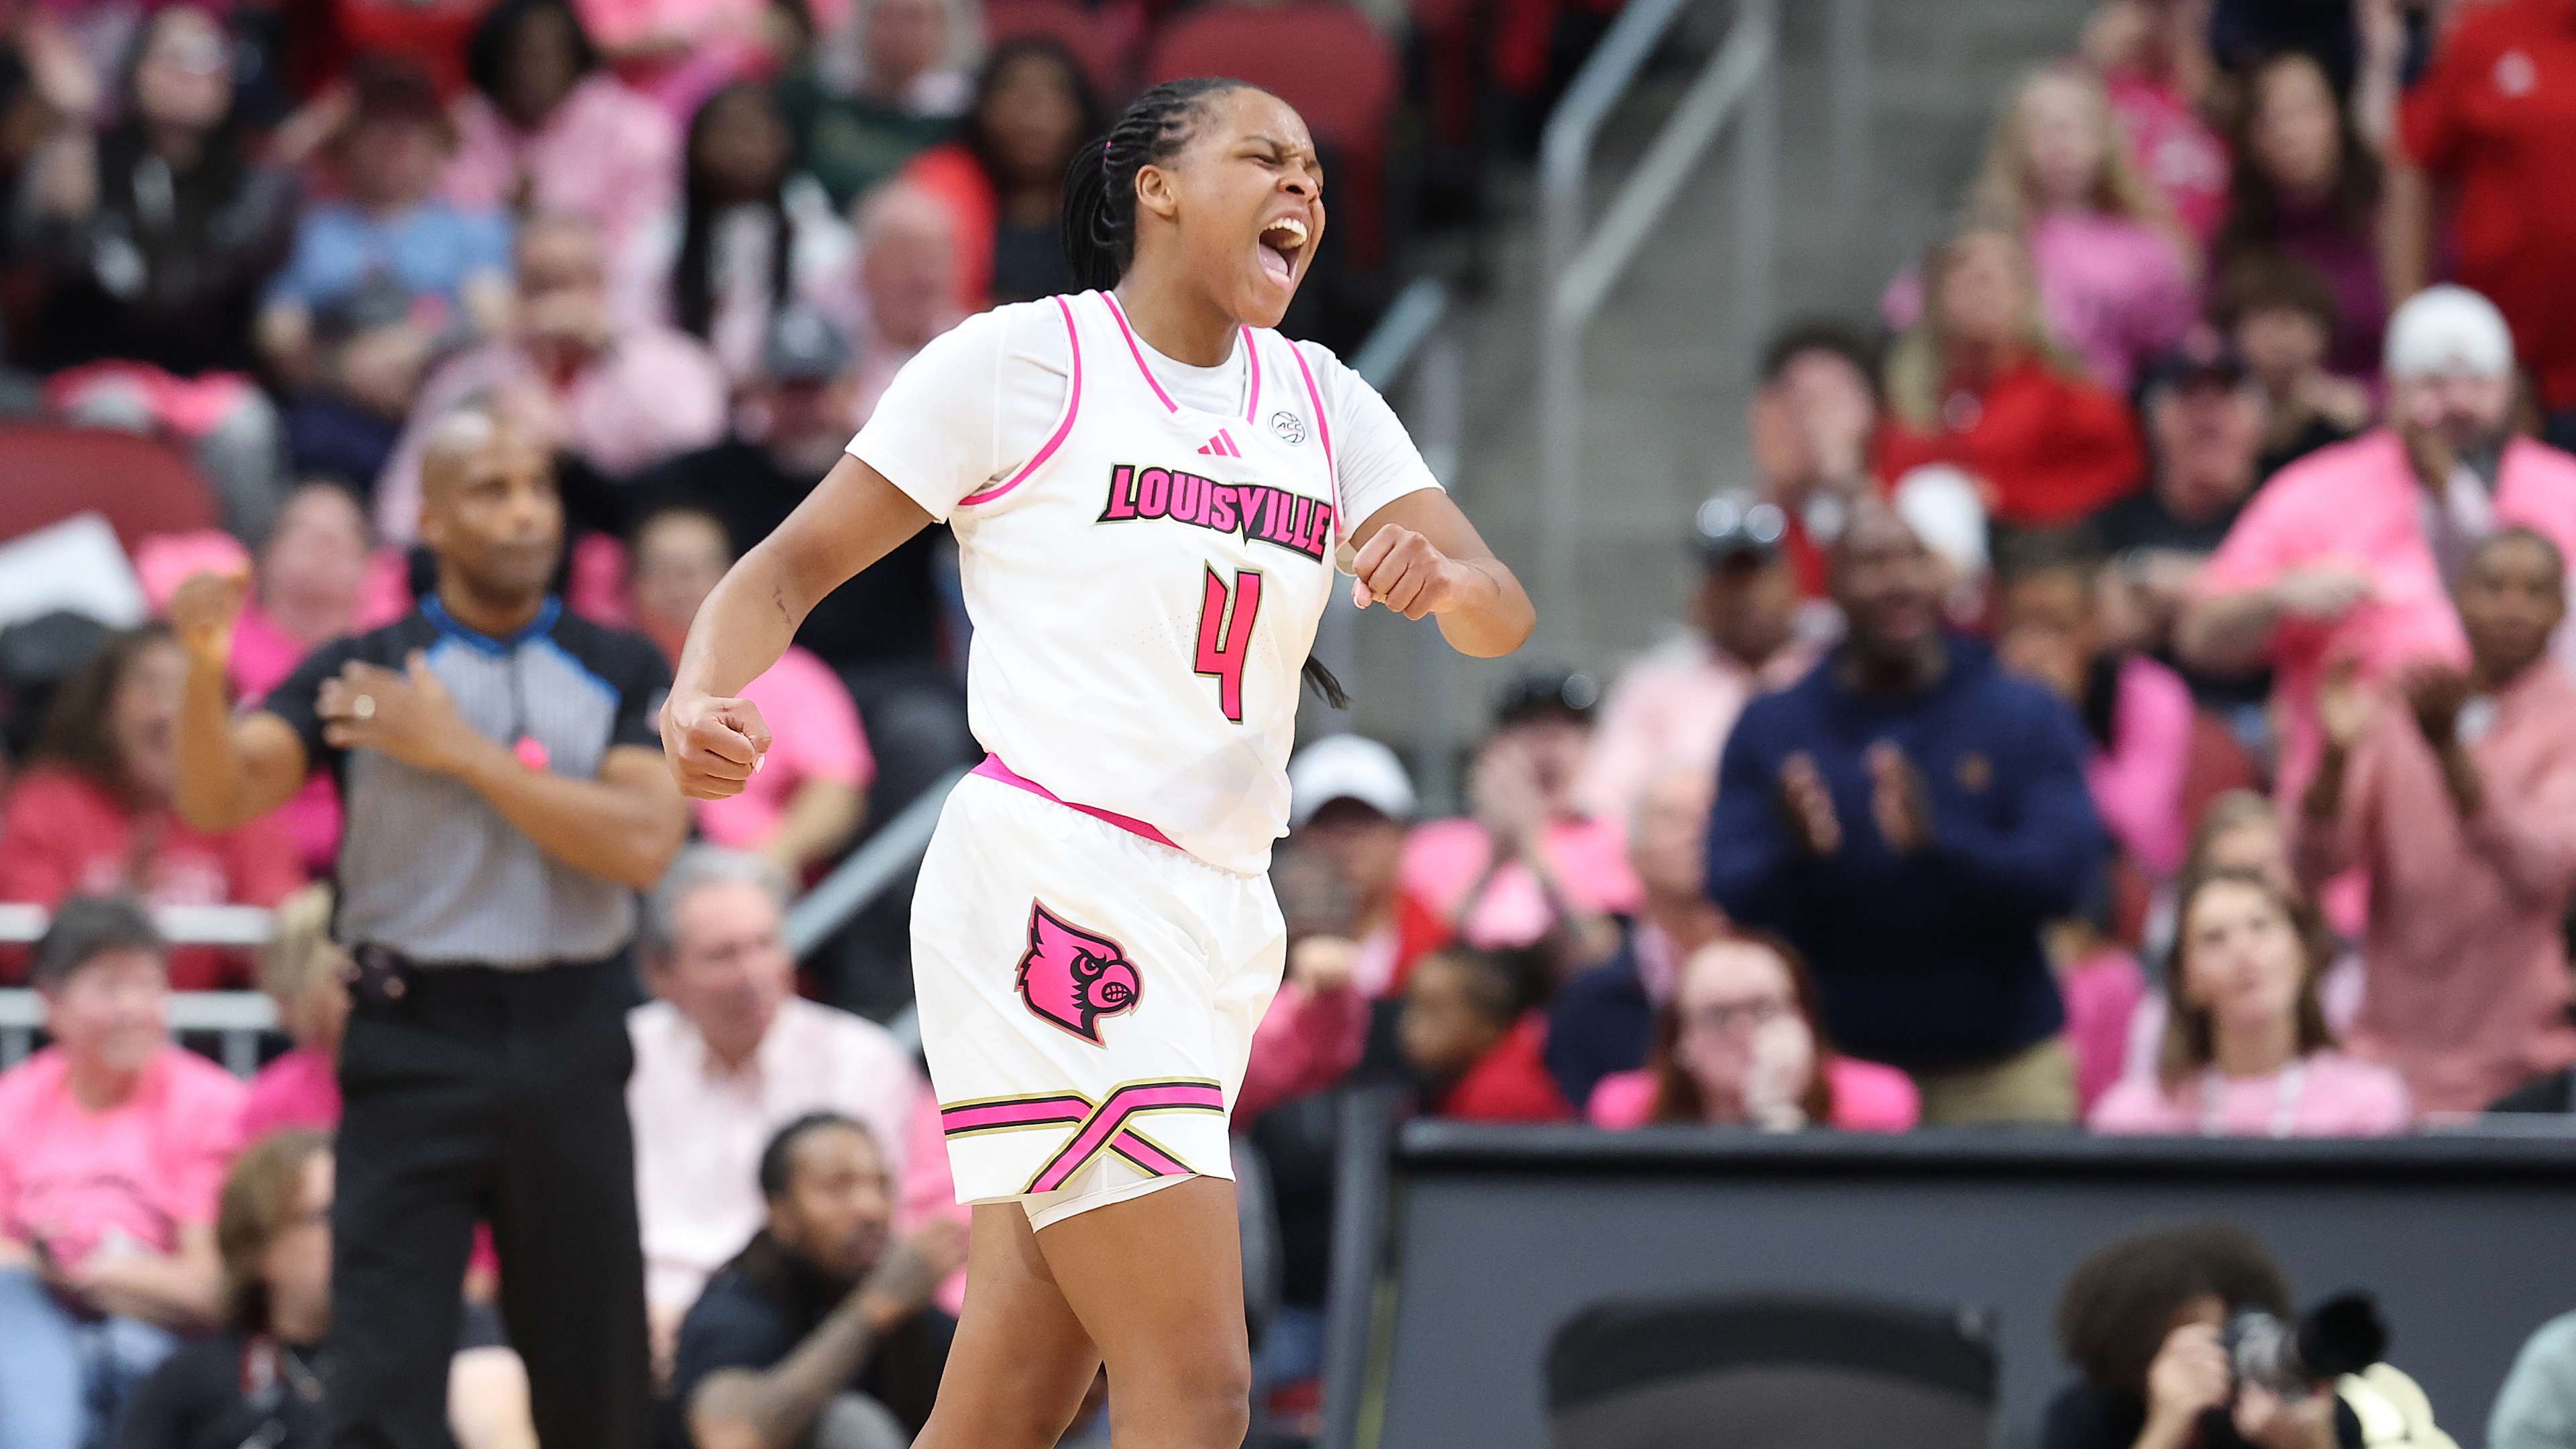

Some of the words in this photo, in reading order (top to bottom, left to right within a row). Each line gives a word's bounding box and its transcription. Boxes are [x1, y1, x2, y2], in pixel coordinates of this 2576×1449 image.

[1276, 422, 1302, 432] ACC
[1096, 463, 1332, 564] LOUISVILLE
[1193, 560, 1263, 724] 4
